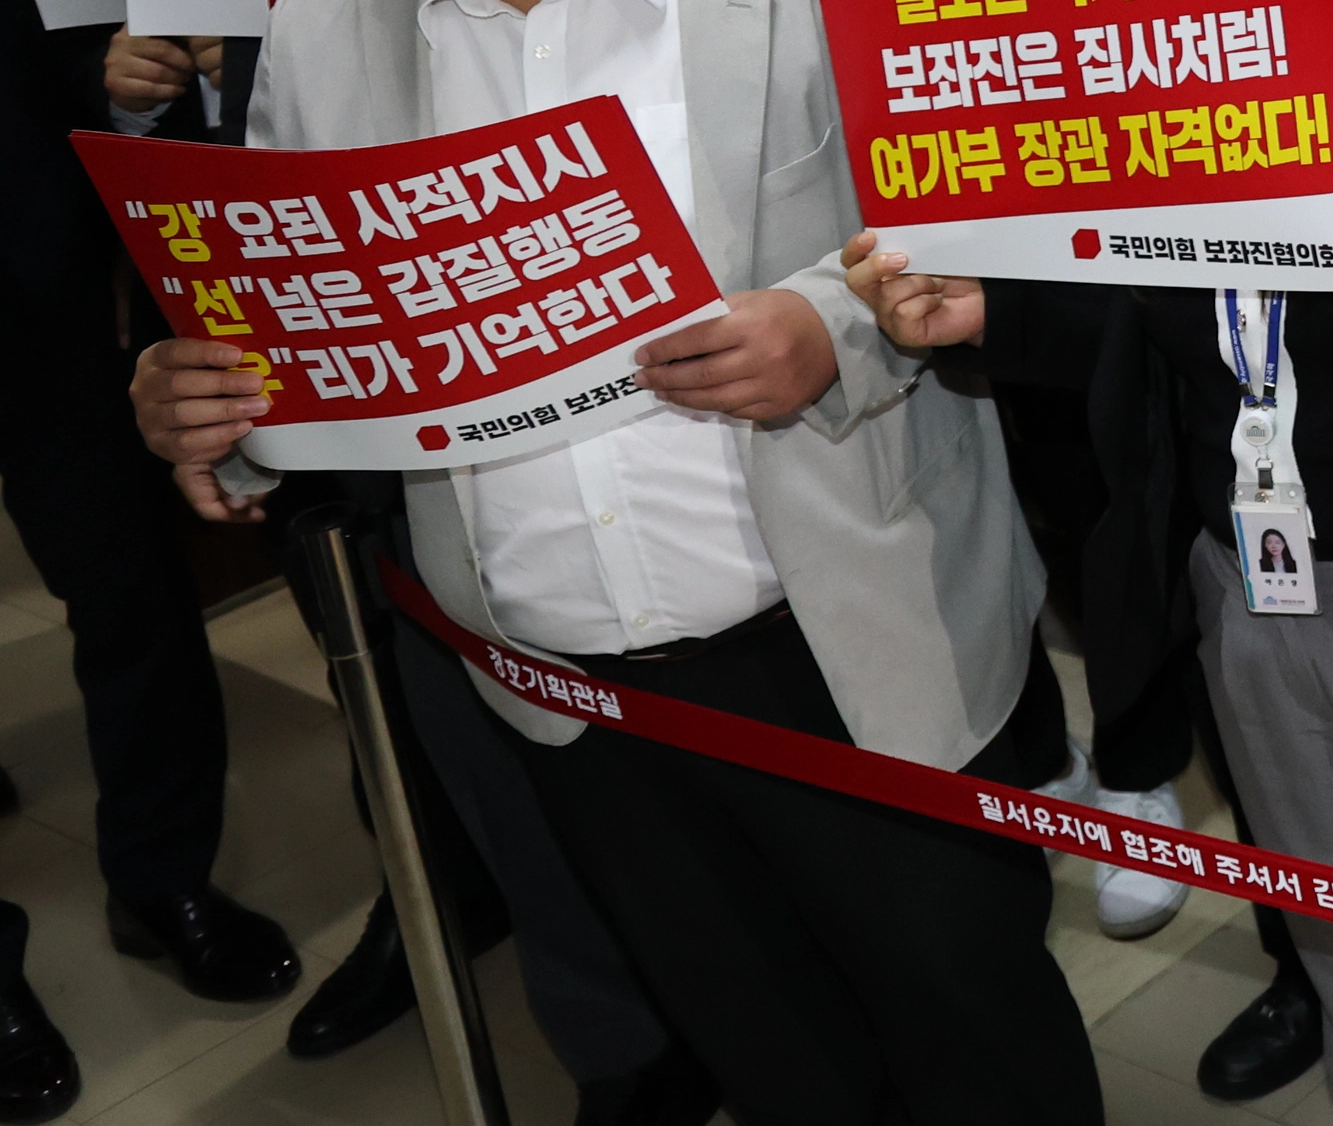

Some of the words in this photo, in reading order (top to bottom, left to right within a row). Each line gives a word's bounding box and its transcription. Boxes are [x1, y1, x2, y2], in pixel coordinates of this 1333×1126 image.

[880, 30, 1066, 114] 보좌진은
[1074, 4, 1289, 97] 집사처럼!
[126, 196, 344, 263] “강”요된
[349, 121, 609, 247] 사적지시
[869, 125, 1007, 200] 여가부
[1014, 116, 1111, 188] 장관
[1120, 92, 1332, 179] 자격없다!
[162, 270, 383, 338] “선”넘은
[378, 188, 642, 320] 갑질행동
[1108, 234, 1198, 263] 국민의힘
[417, 253, 674, 377] 기억한다
[456, 403, 561, 442] 국민의힘
[564, 373, 646, 416] 보좌진
[487, 645, 624, 721] 경호기획관실
[976, 792, 1113, 853] 질서유지에
[1120, 829, 1206, 877] 협조해
[1215, 853, 1303, 902] 주셔서
